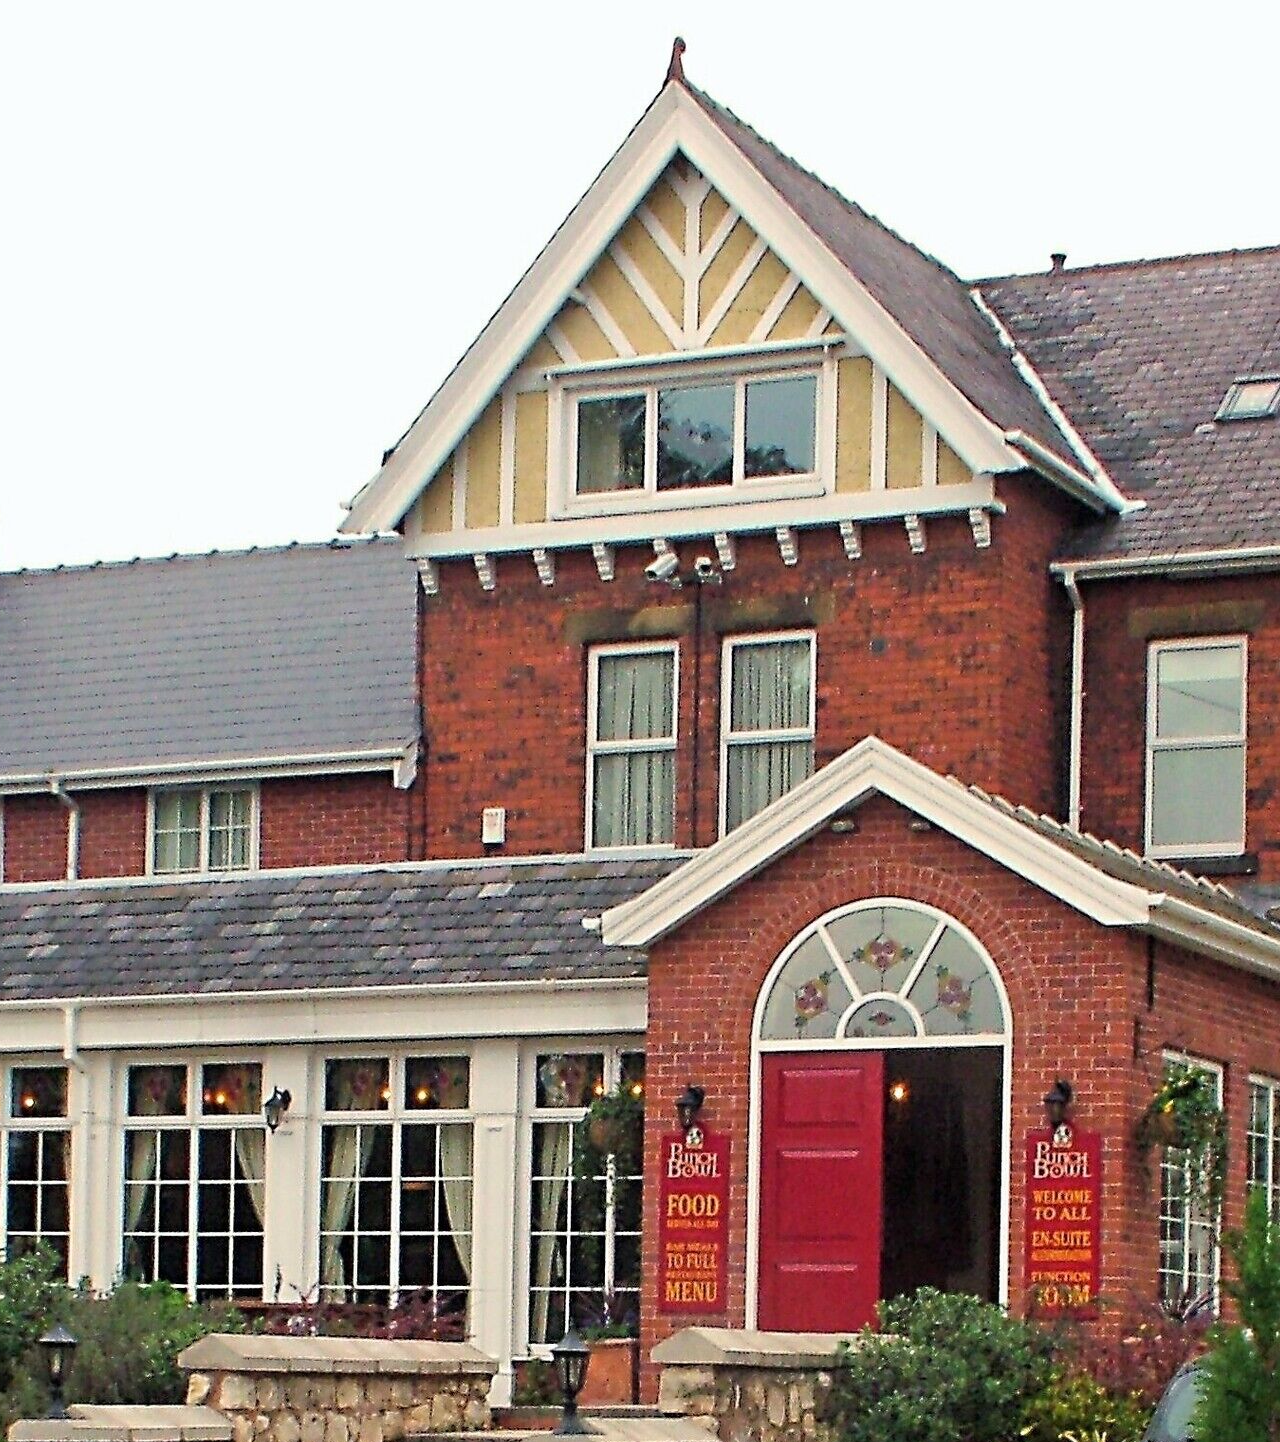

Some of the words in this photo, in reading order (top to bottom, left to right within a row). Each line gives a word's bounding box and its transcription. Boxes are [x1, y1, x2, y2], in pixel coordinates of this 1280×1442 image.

[1033, 1190, 1093, 1204] WELCOME
[667, 1193, 719, 1217] FOOD
[1032, 1206, 1056, 1220] TO
[1060, 1206, 1092, 1220] ALL
[1032, 1231, 1091, 1247] EN-SUITE
[667, 1253, 683, 1268] TO
[687, 1253, 717, 1268] FULL
[666, 1281, 717, 1302] MENU
